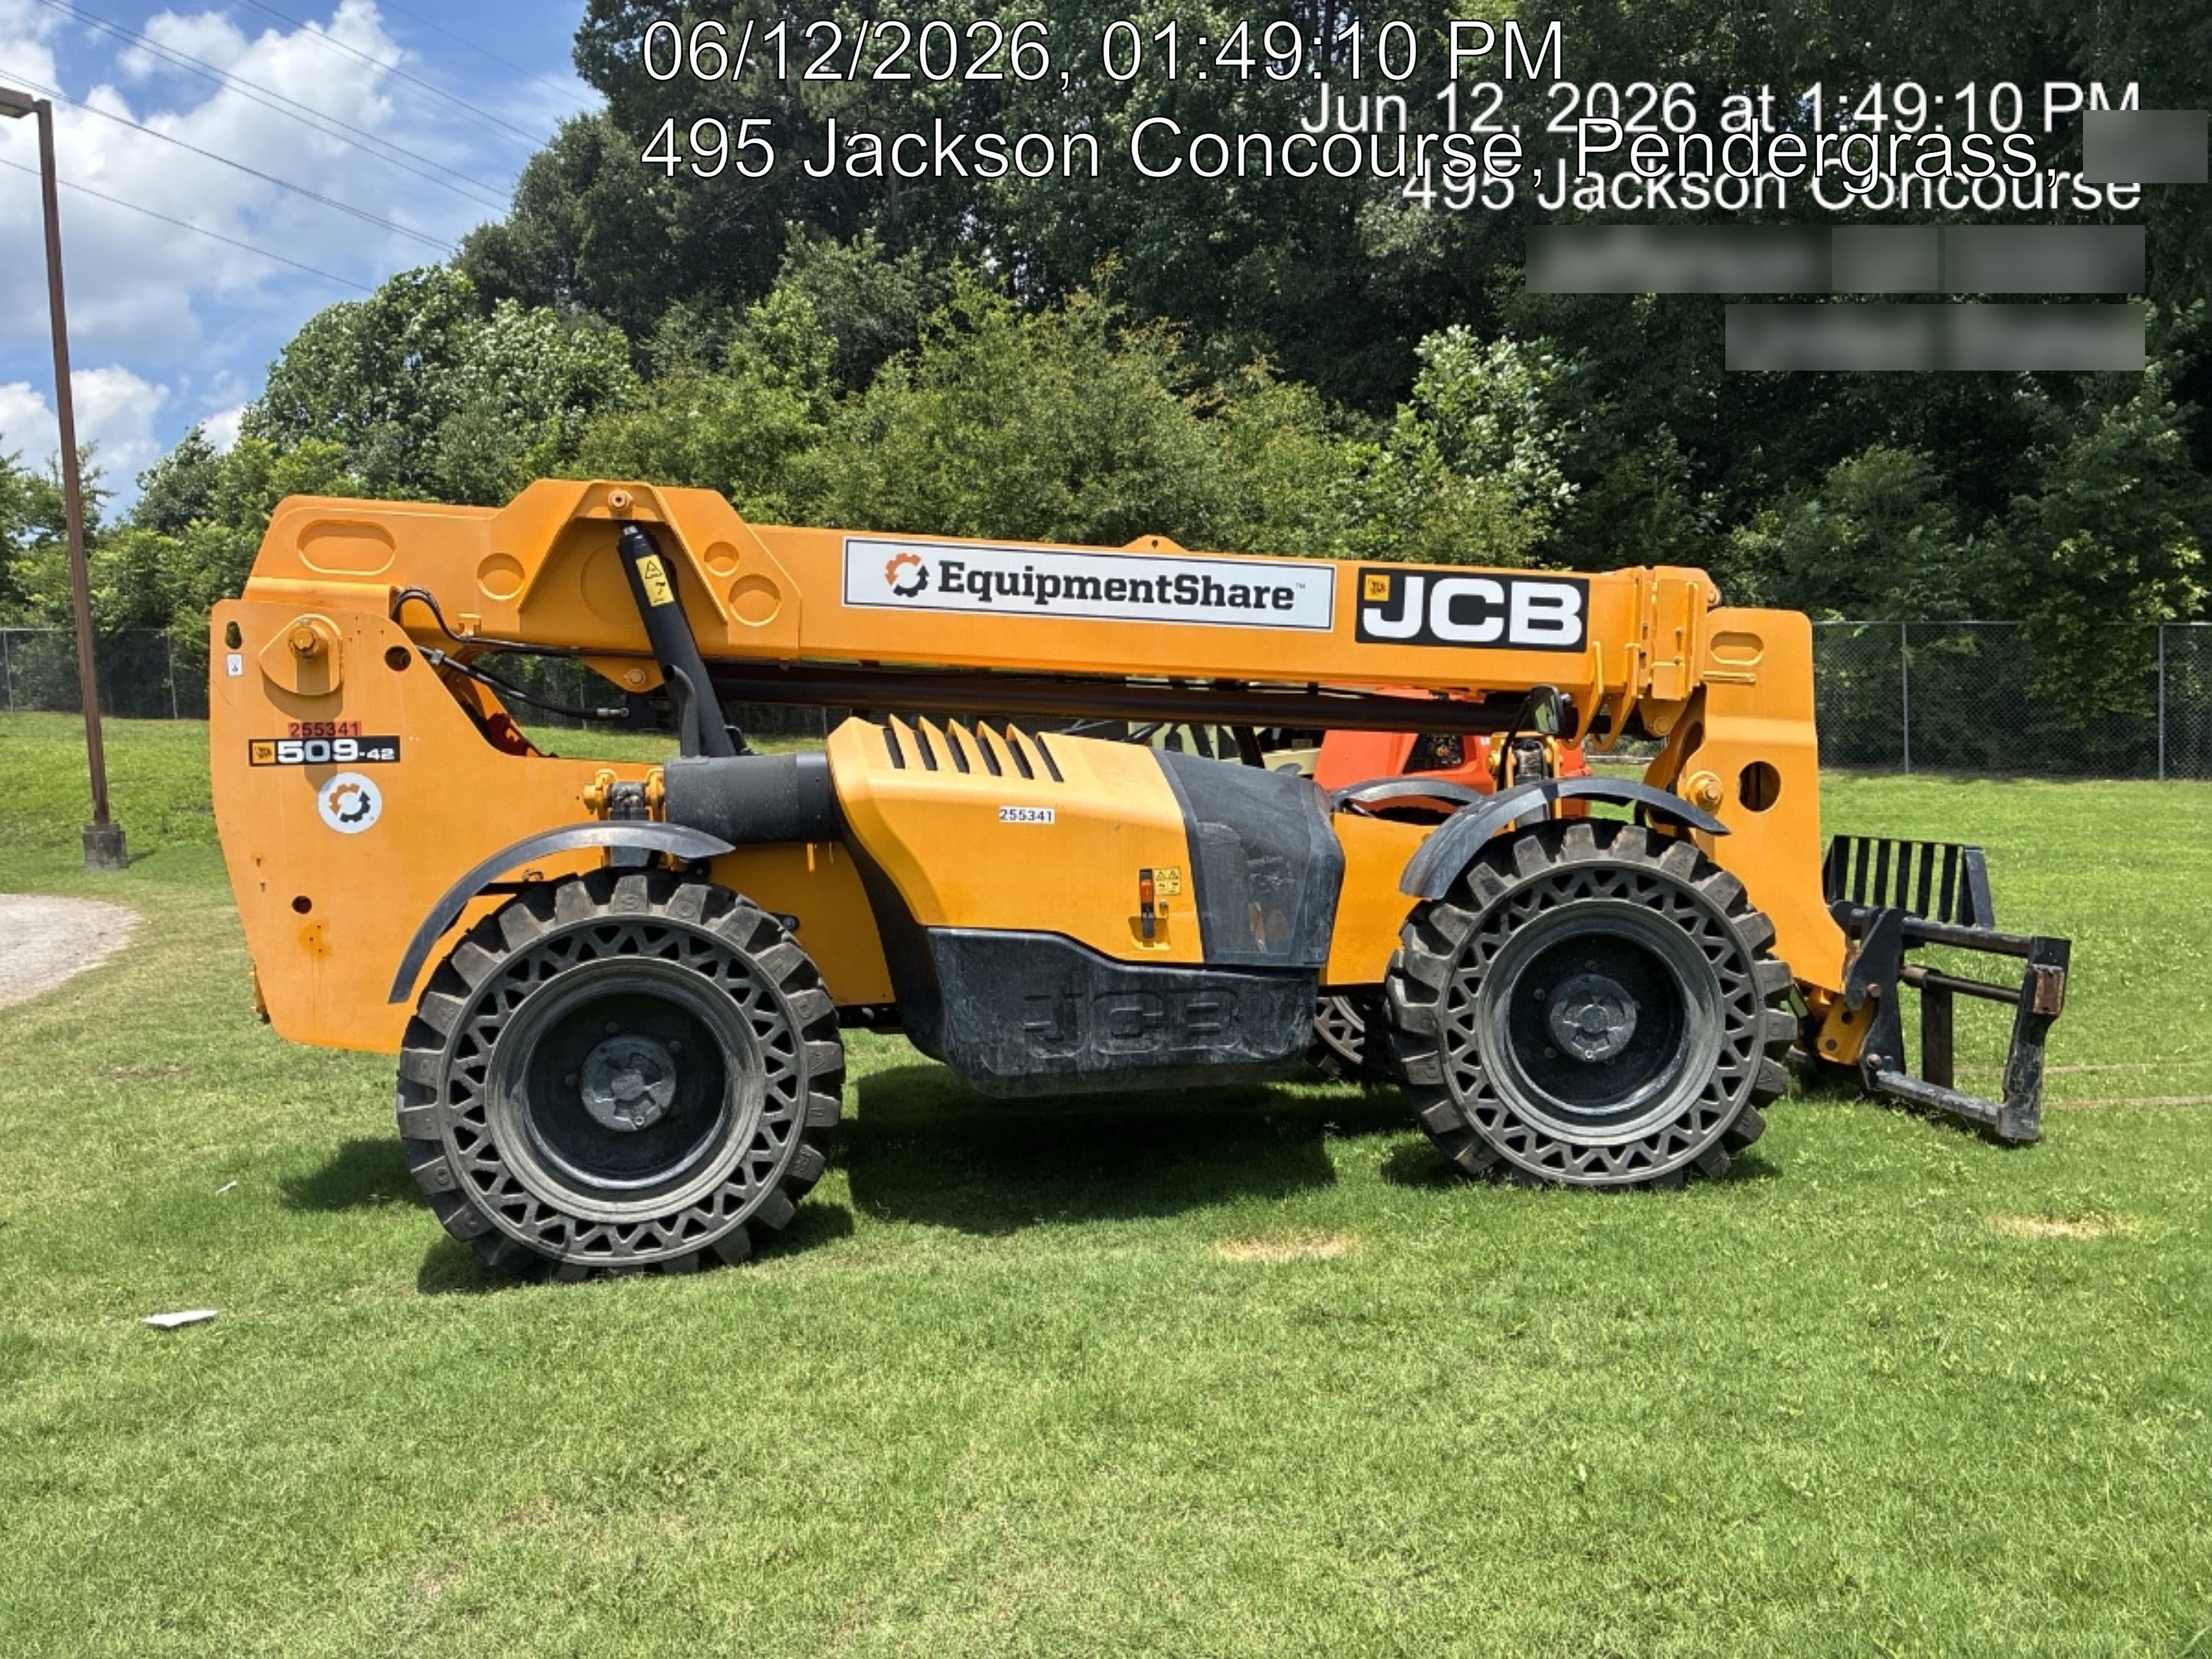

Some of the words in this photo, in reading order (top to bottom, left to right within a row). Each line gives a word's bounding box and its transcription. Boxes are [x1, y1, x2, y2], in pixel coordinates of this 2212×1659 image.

[938, 560, 1294, 610] EquipmentShare
[1363, 576, 1582, 646] JCB
[289, 721, 359, 737] 255341
[277, 739, 396, 763] 509-42
[998, 808, 1052, 823] 255341
[1024, 986, 1241, 1059] JCB
